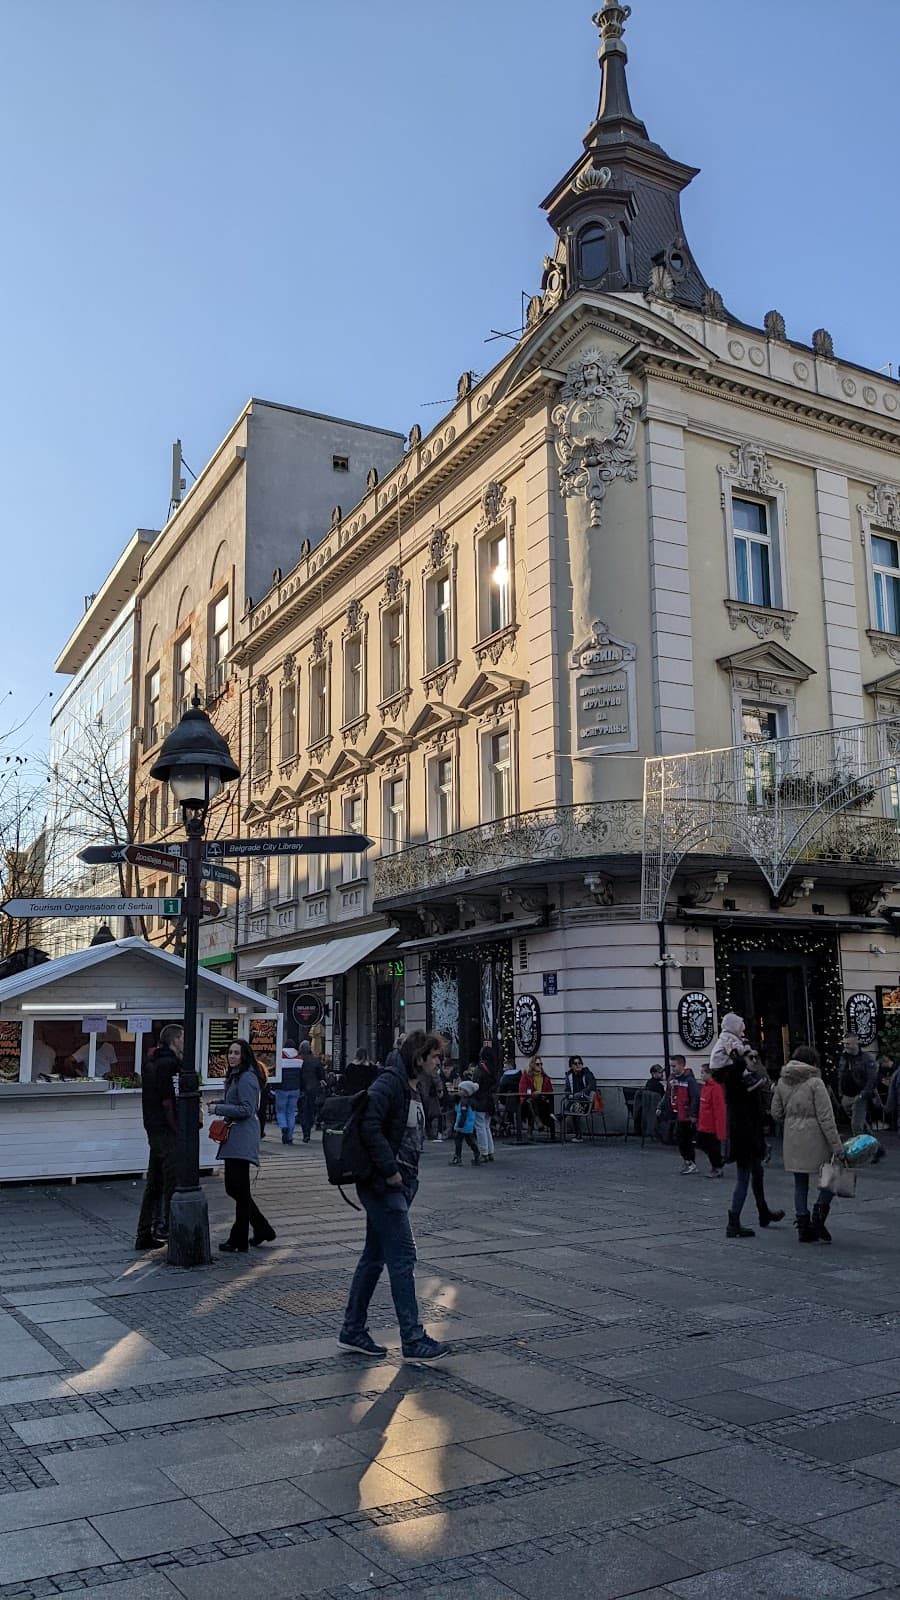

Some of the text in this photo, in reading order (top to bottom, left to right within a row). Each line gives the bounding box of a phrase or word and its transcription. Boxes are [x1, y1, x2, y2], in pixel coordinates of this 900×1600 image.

[229, 842, 303, 853] Belgrade City Library
[29, 902, 153, 913] Tourism Organisation of Serbia
[681, 1001, 689, 1018] THE
